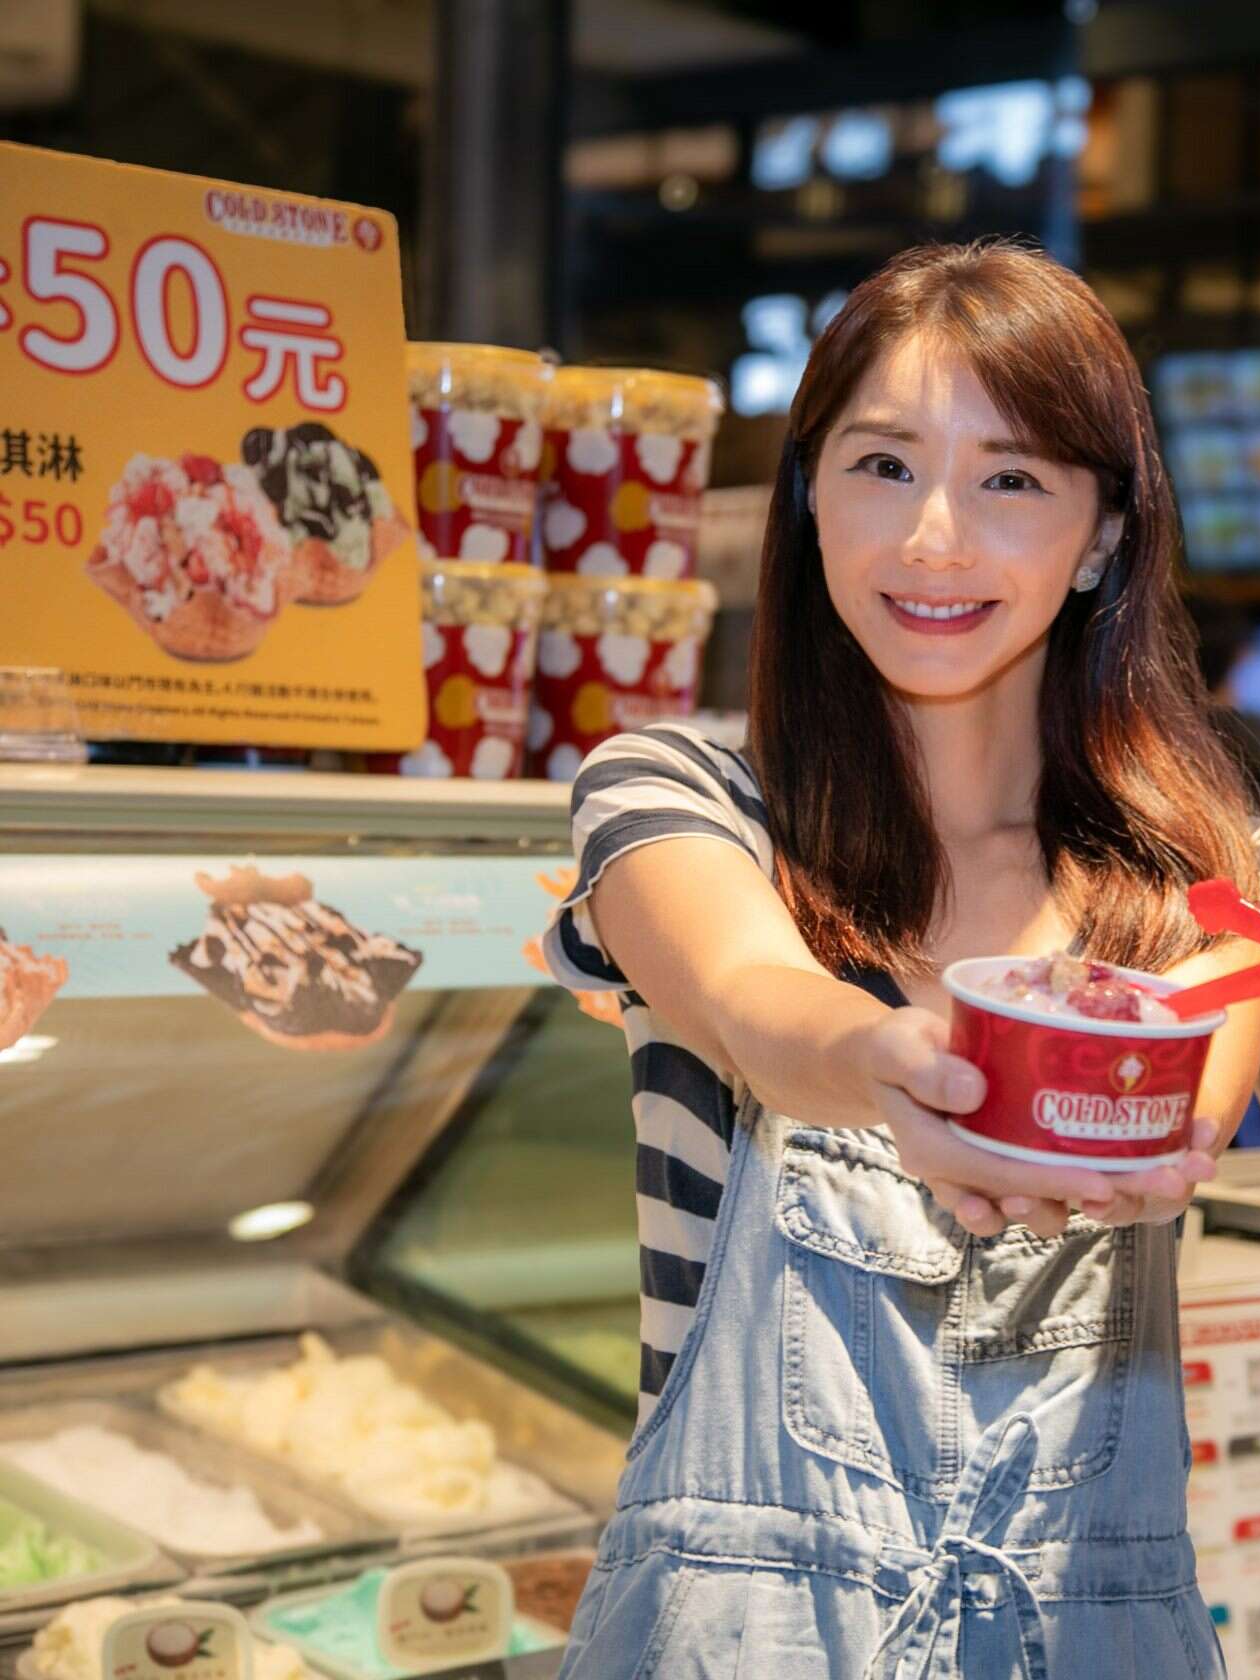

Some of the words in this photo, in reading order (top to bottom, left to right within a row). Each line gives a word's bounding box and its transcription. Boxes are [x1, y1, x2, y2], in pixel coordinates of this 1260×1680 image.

[206, 190, 268, 223] COLD
[0, 214, 349, 413] 50元
[1032, 1088, 1114, 1130] COLD
[1112, 1092, 1191, 1131] STONE
